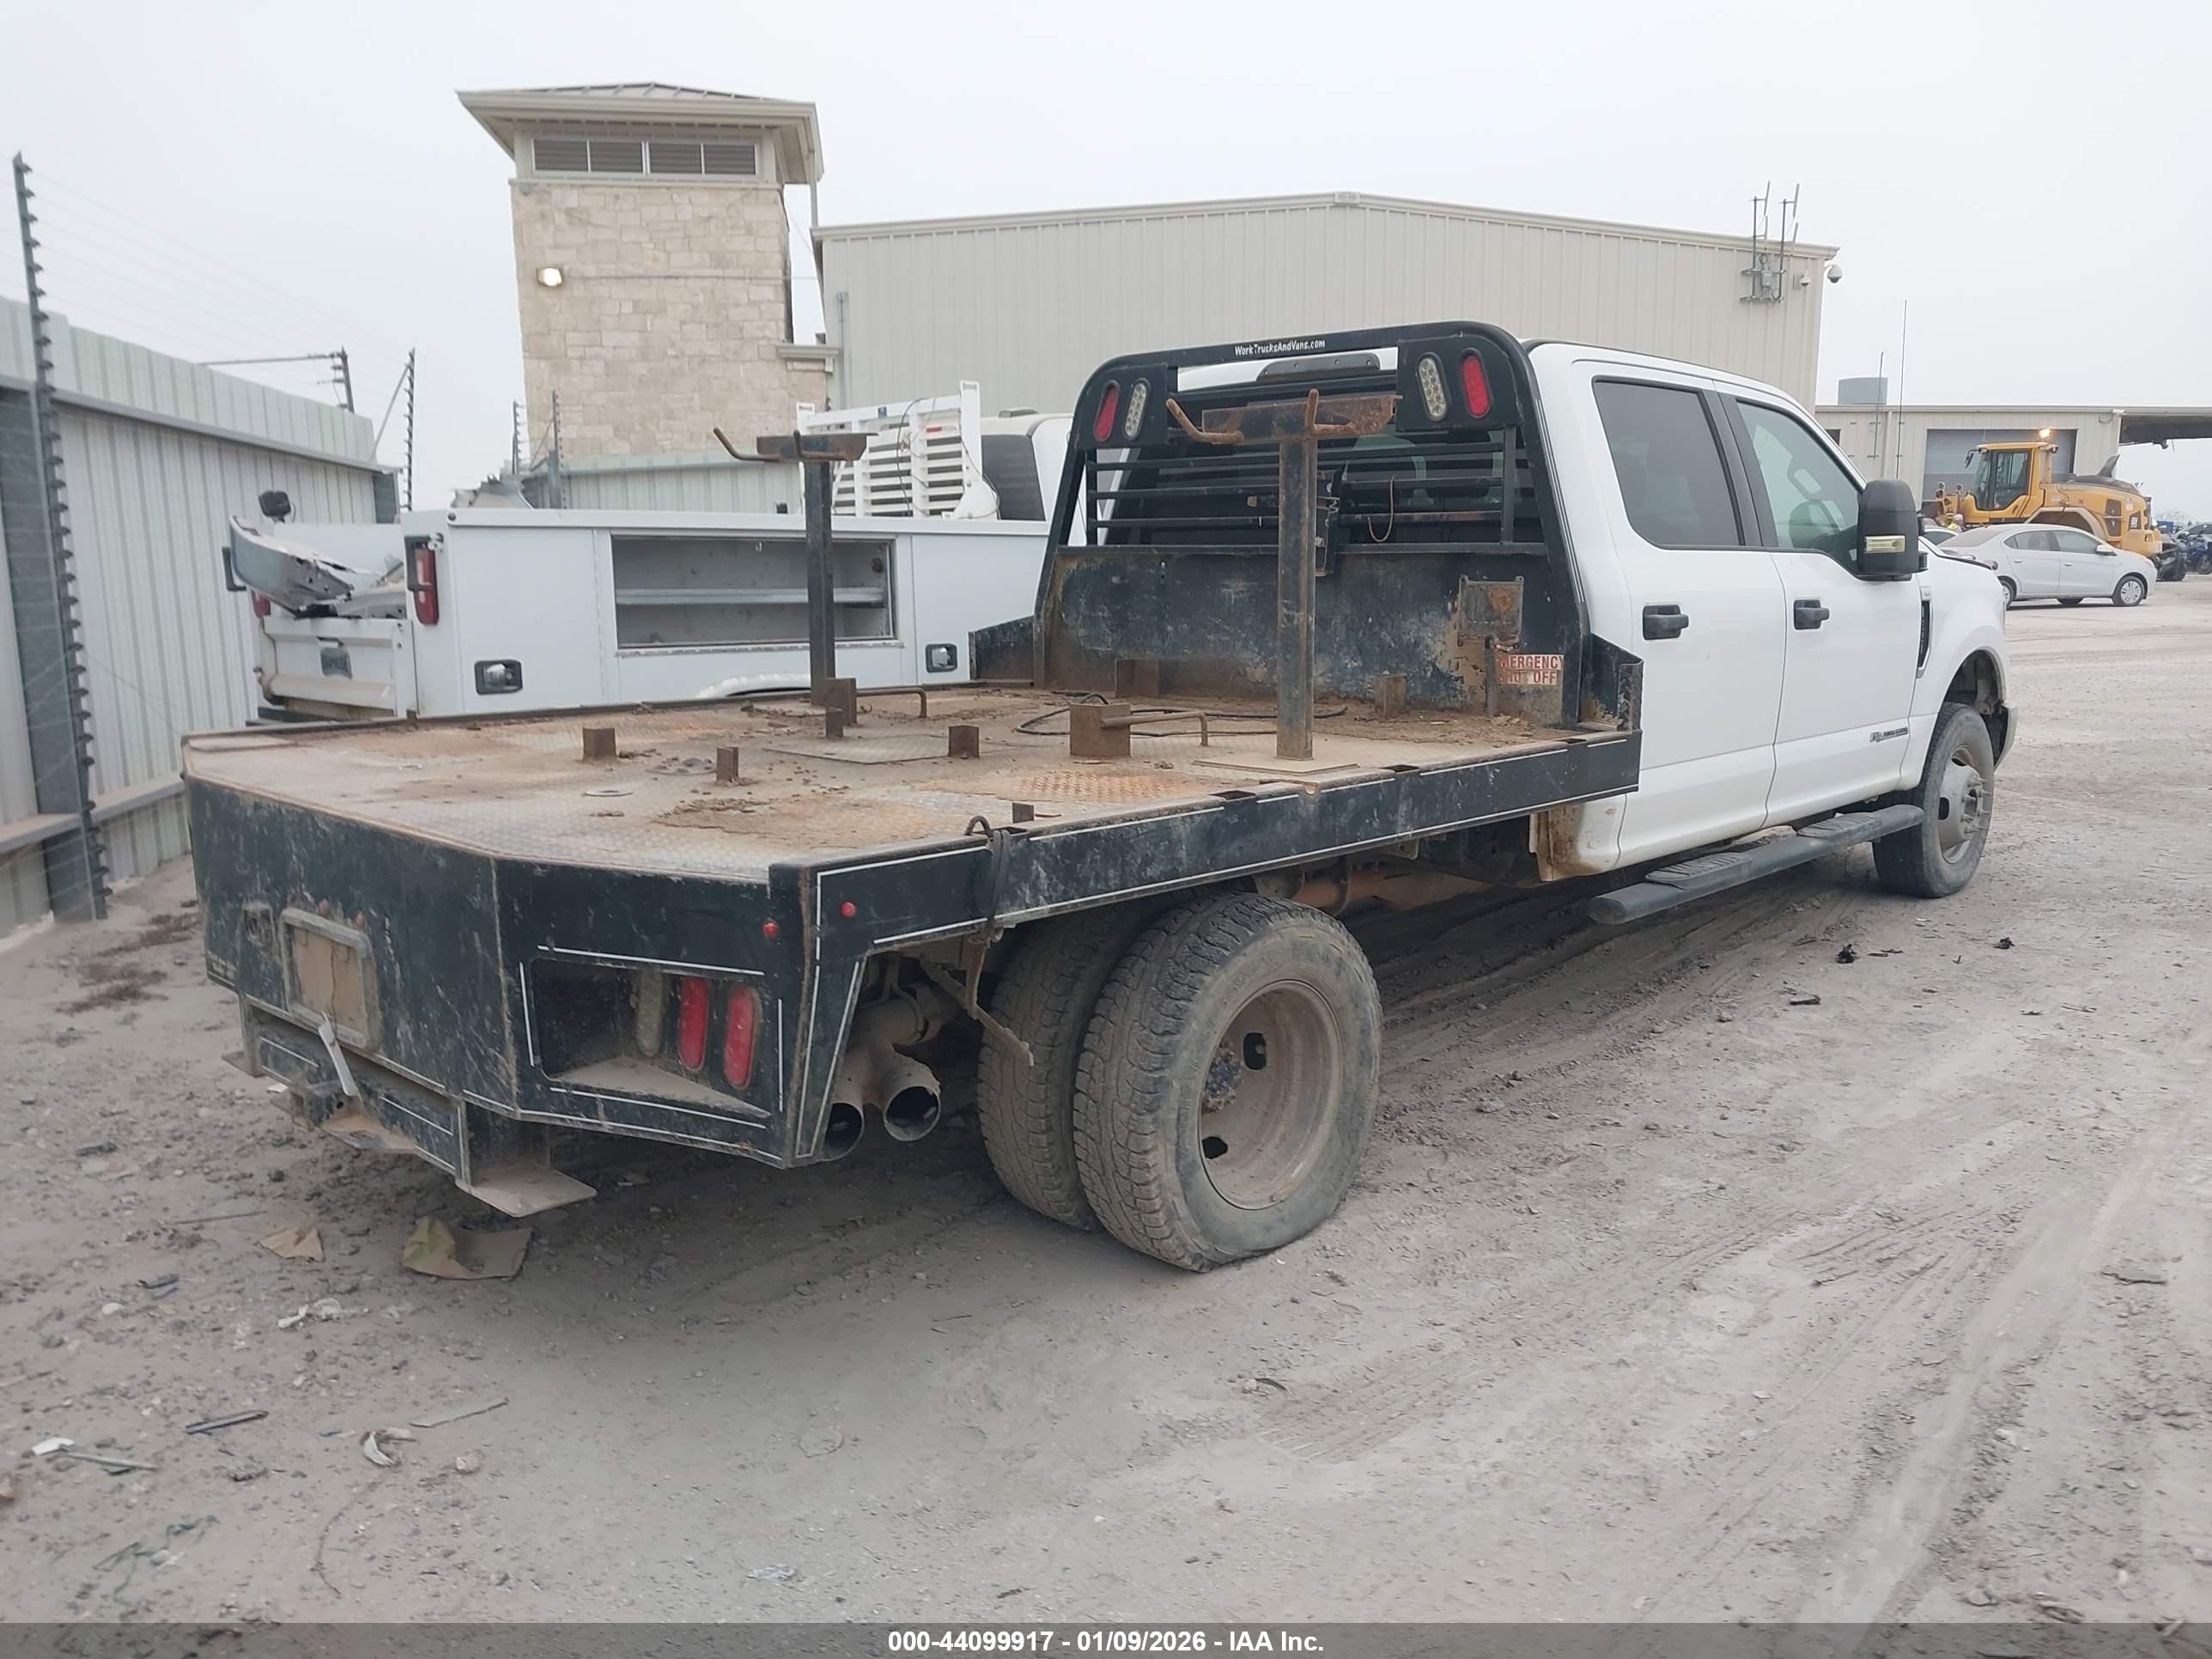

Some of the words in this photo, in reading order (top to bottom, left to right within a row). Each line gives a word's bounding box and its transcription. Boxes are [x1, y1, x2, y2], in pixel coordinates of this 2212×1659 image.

[1234, 339, 1326, 356] WorkTrucksAndVans.com
[1498, 655, 1565, 669] MERGENCY
[1533, 671, 1557, 684] OFF
